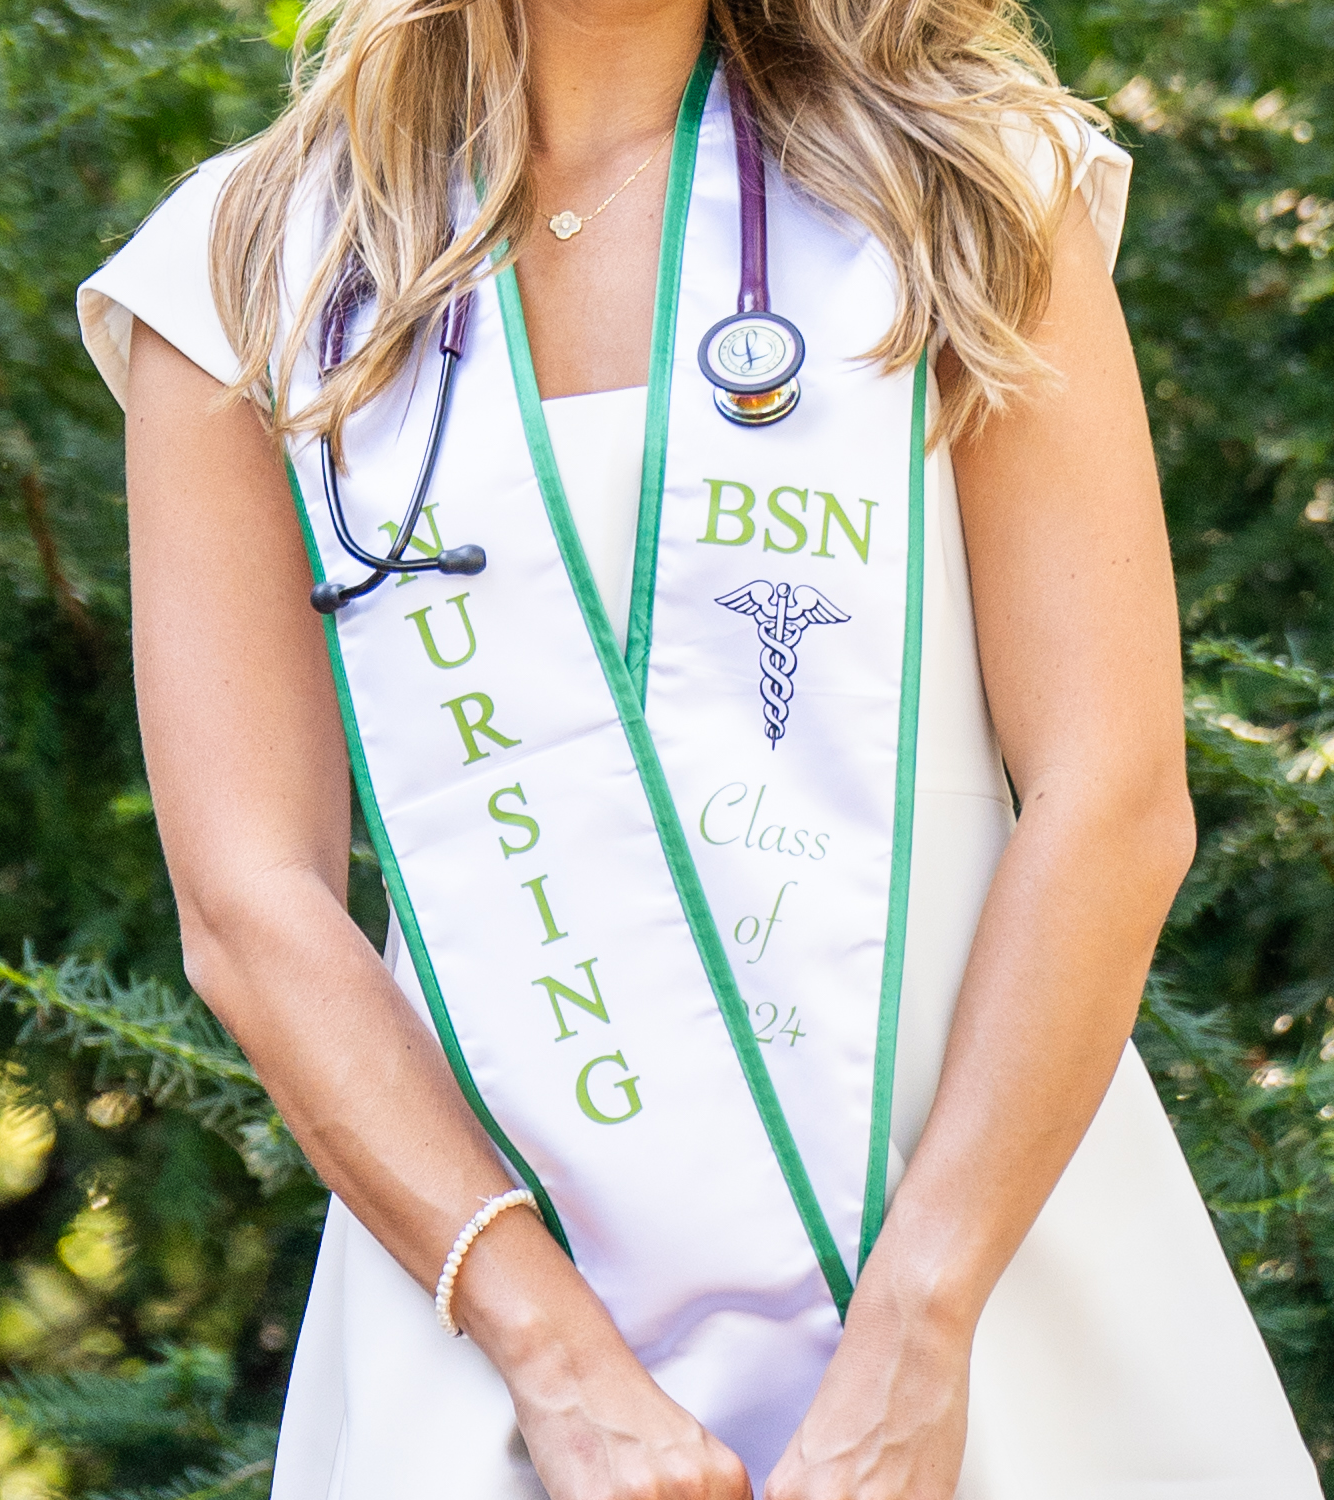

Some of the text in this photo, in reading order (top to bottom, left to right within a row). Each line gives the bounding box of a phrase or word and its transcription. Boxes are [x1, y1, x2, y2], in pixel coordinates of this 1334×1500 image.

[696, 478, 879, 565] BSN
[699, 781, 830, 860] Class
[734, 881, 798, 964] of
[741, 999, 807, 1047] 24
